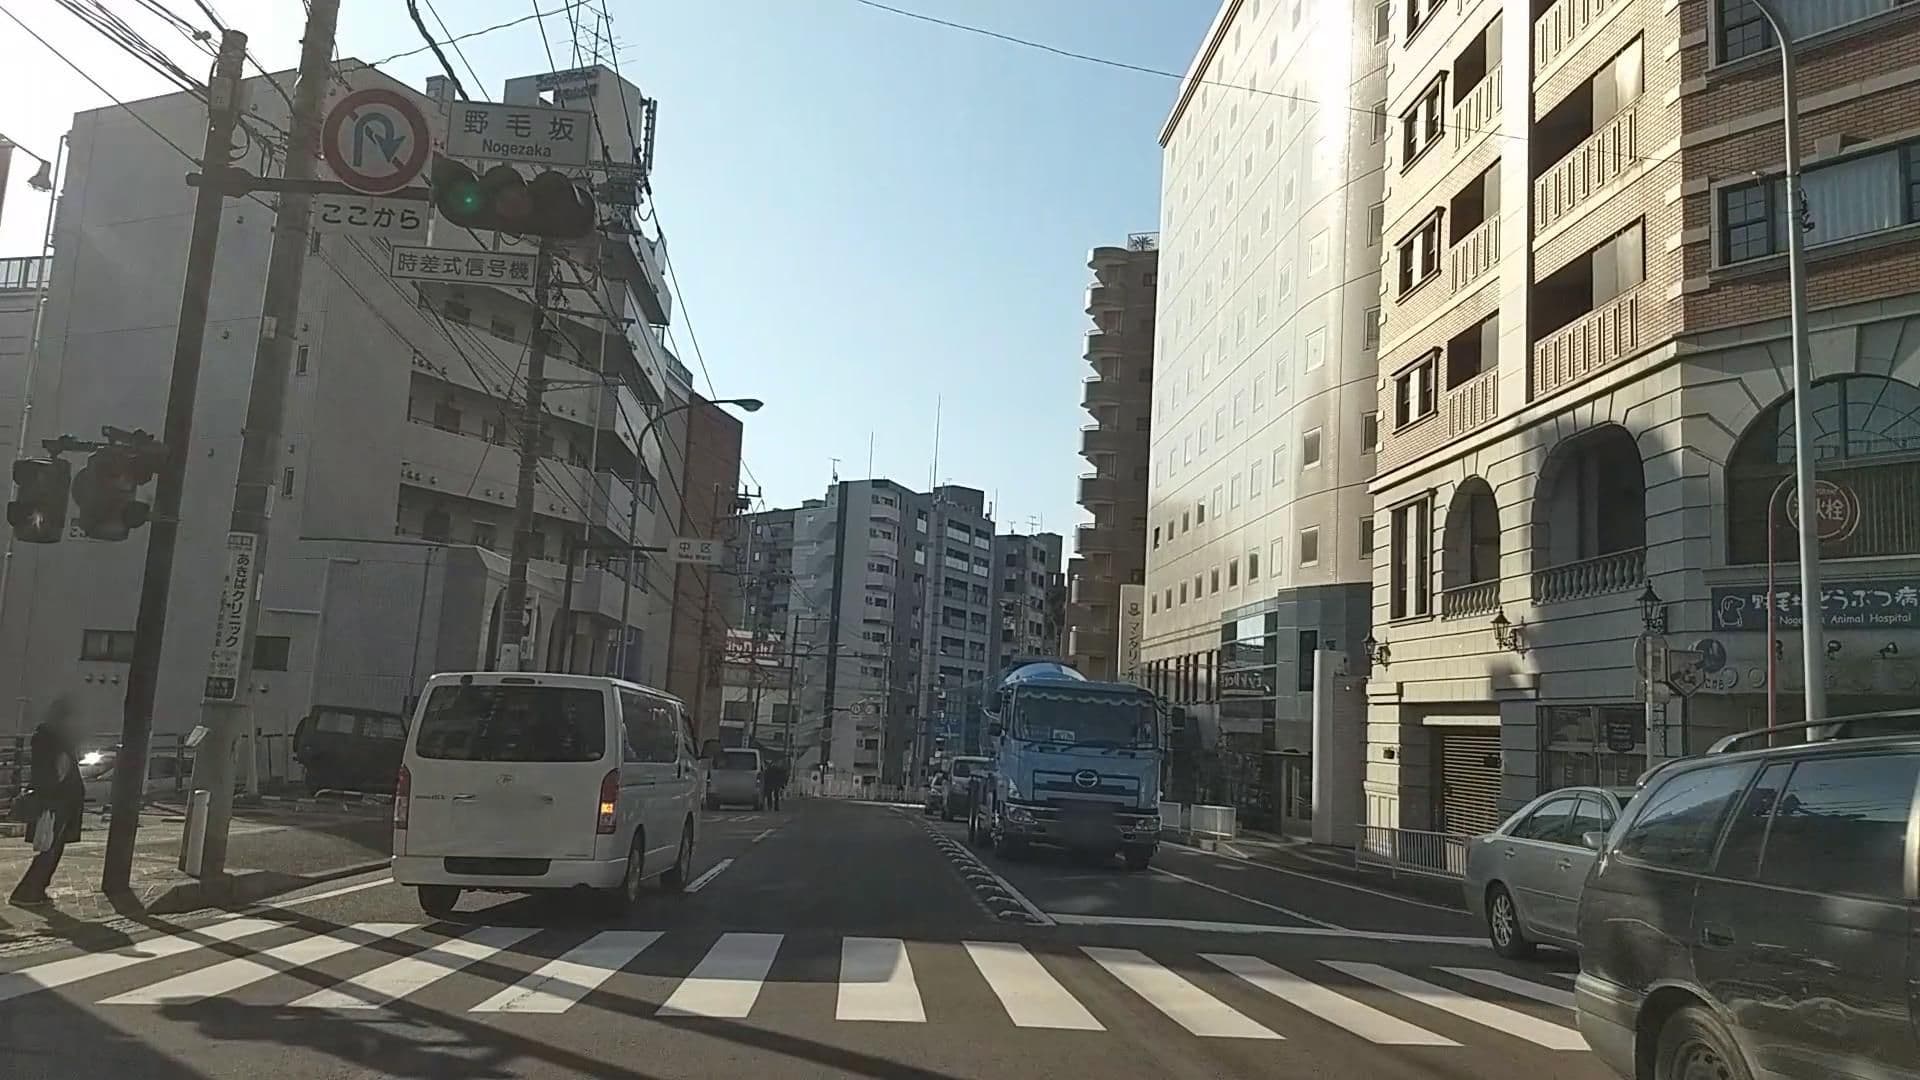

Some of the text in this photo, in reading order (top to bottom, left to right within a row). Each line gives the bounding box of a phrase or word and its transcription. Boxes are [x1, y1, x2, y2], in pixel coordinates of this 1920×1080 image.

[463, 109, 575, 142] 野毛坂
[482, 138, 551, 158] Nogezaka
[321, 203, 420, 230] ここから
[398, 253, 530, 281] 時差式信号機
[1793, 497, 1845, 521] 火栓
[1830, 612, 1864, 624] Animal
[1869, 612, 1912, 625] Hospital
